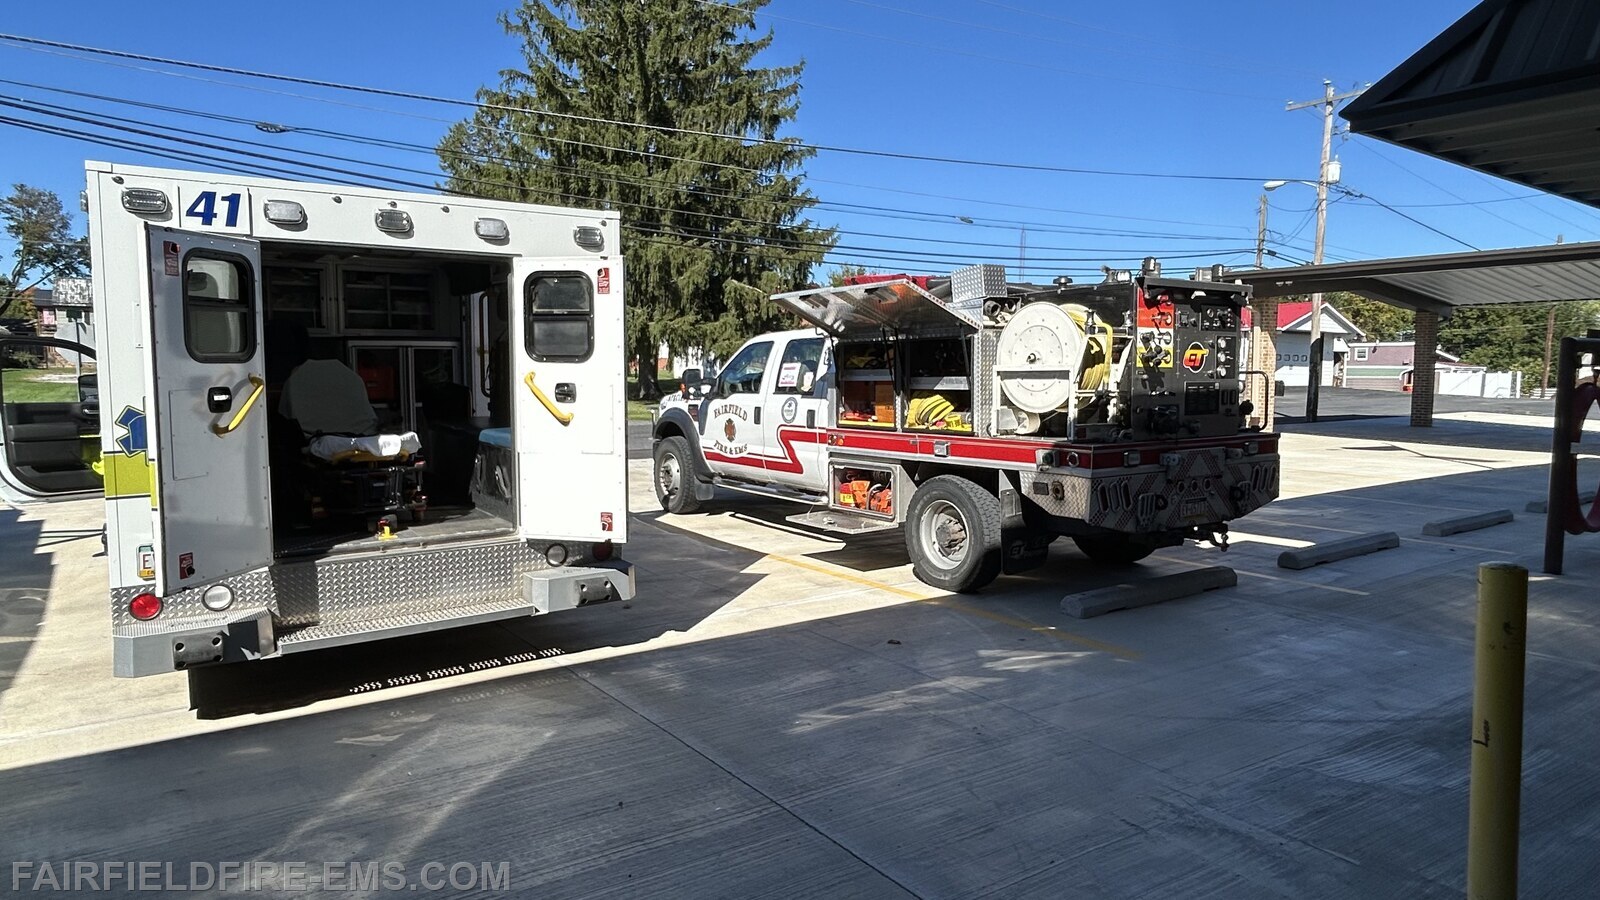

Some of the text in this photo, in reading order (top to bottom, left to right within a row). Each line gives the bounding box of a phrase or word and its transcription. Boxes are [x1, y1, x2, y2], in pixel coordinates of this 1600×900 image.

[185, 191, 241, 228] 41
[713, 403, 748, 421] FAIRFIELD
[713, 439, 748, 455] FIRE & EMS
